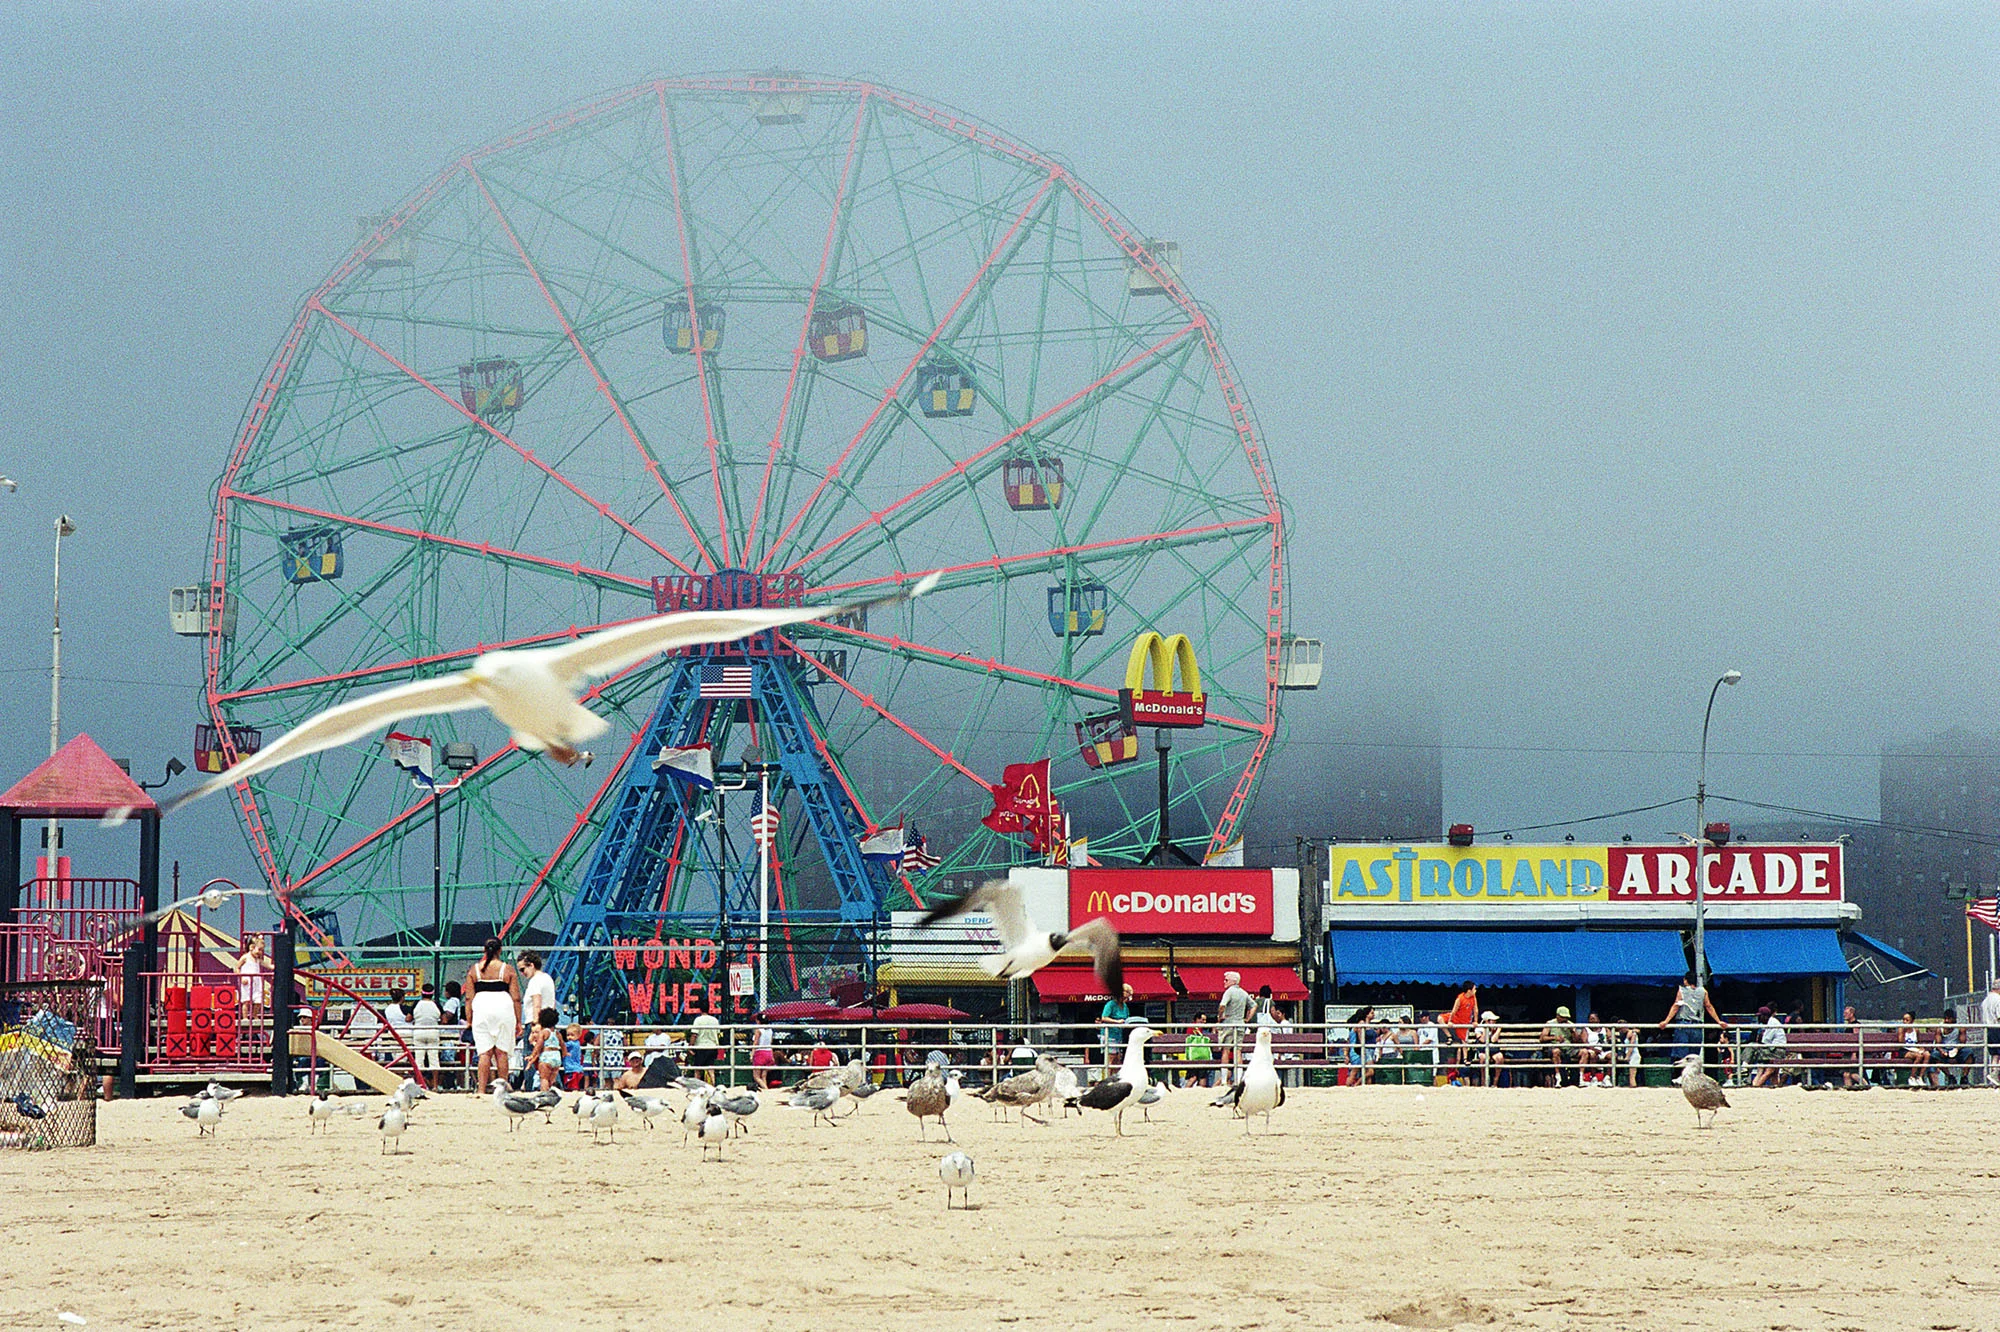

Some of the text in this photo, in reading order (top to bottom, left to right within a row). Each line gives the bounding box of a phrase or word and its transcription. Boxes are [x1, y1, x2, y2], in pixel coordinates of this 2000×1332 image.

[652, 574, 804, 612] WONDER
[1135, 702, 1203, 716] McDonald's
[1338, 847, 1830, 900] ASTROLAND ARCADE
[1087, 890, 1256, 913] McDonald's
[322, 976, 409, 989] TICKETS
[730, 972, 742, 992] NO
